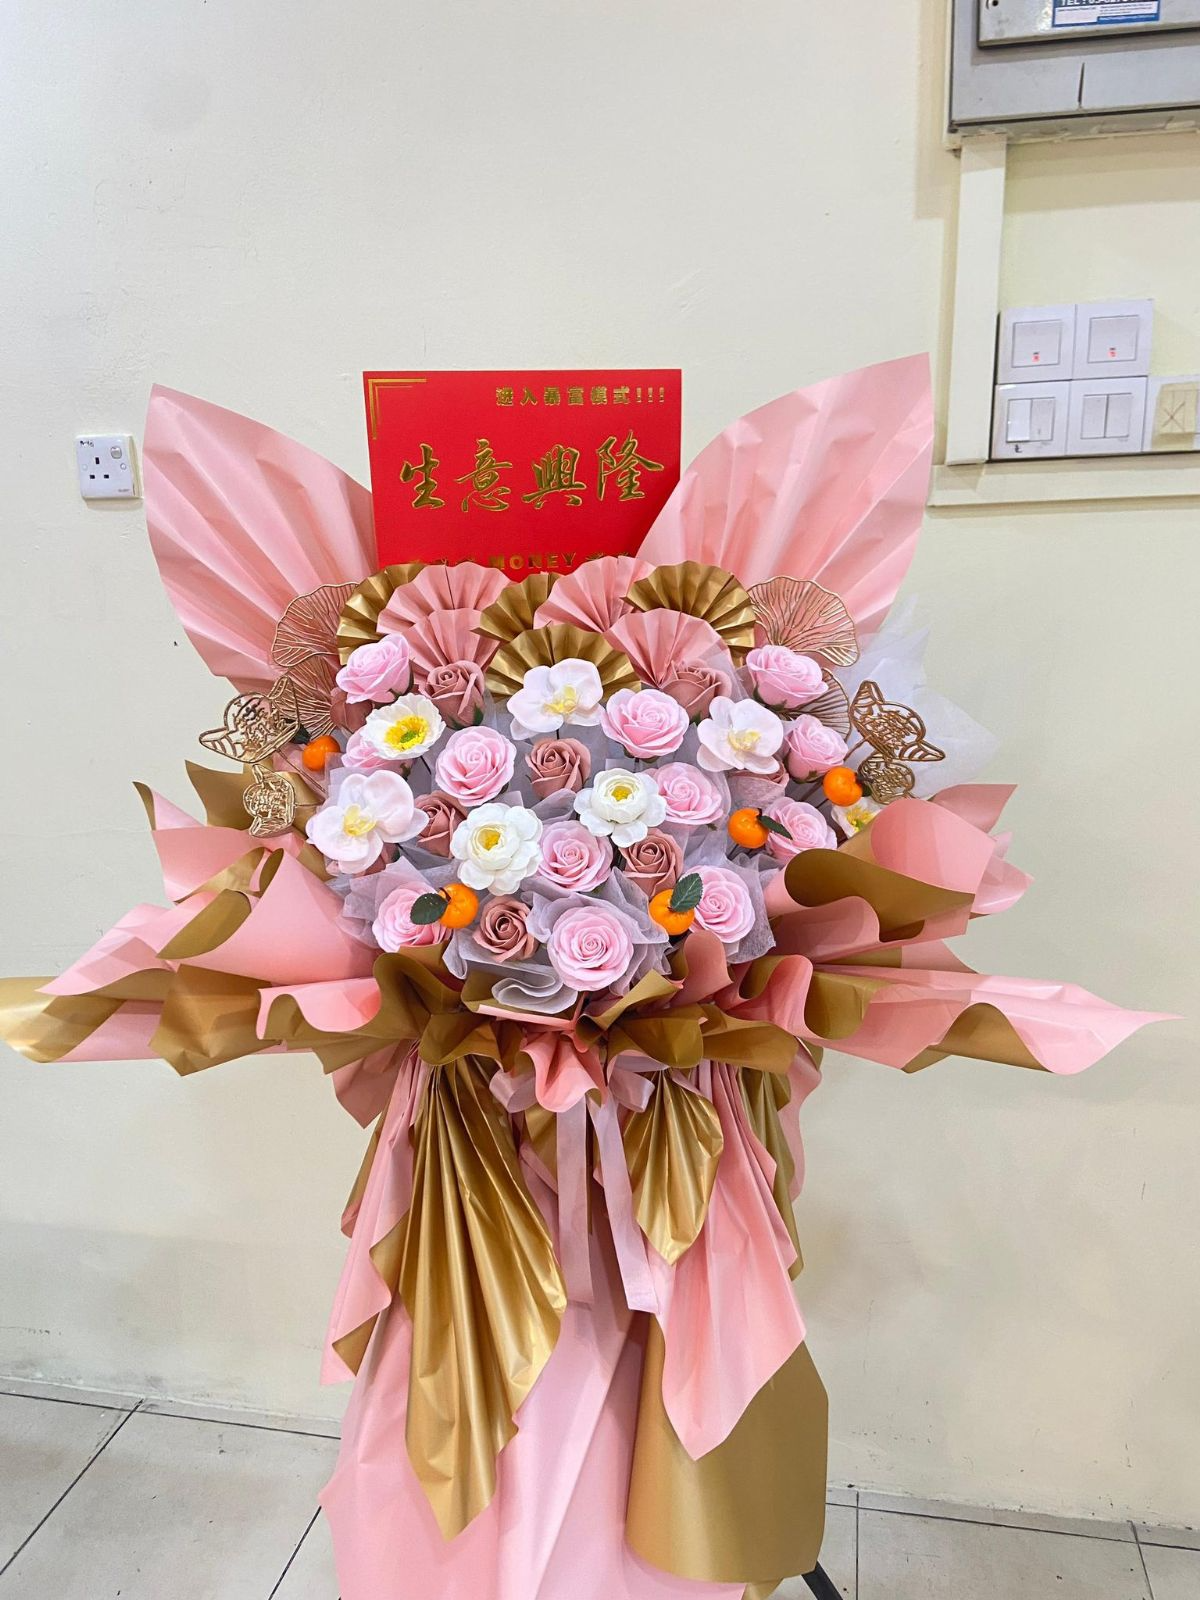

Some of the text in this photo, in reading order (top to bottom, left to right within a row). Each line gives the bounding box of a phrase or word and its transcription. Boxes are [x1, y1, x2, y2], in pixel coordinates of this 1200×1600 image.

[399, 430, 664, 512] 生意興隆
[489, 552, 576, 570] MONEY
